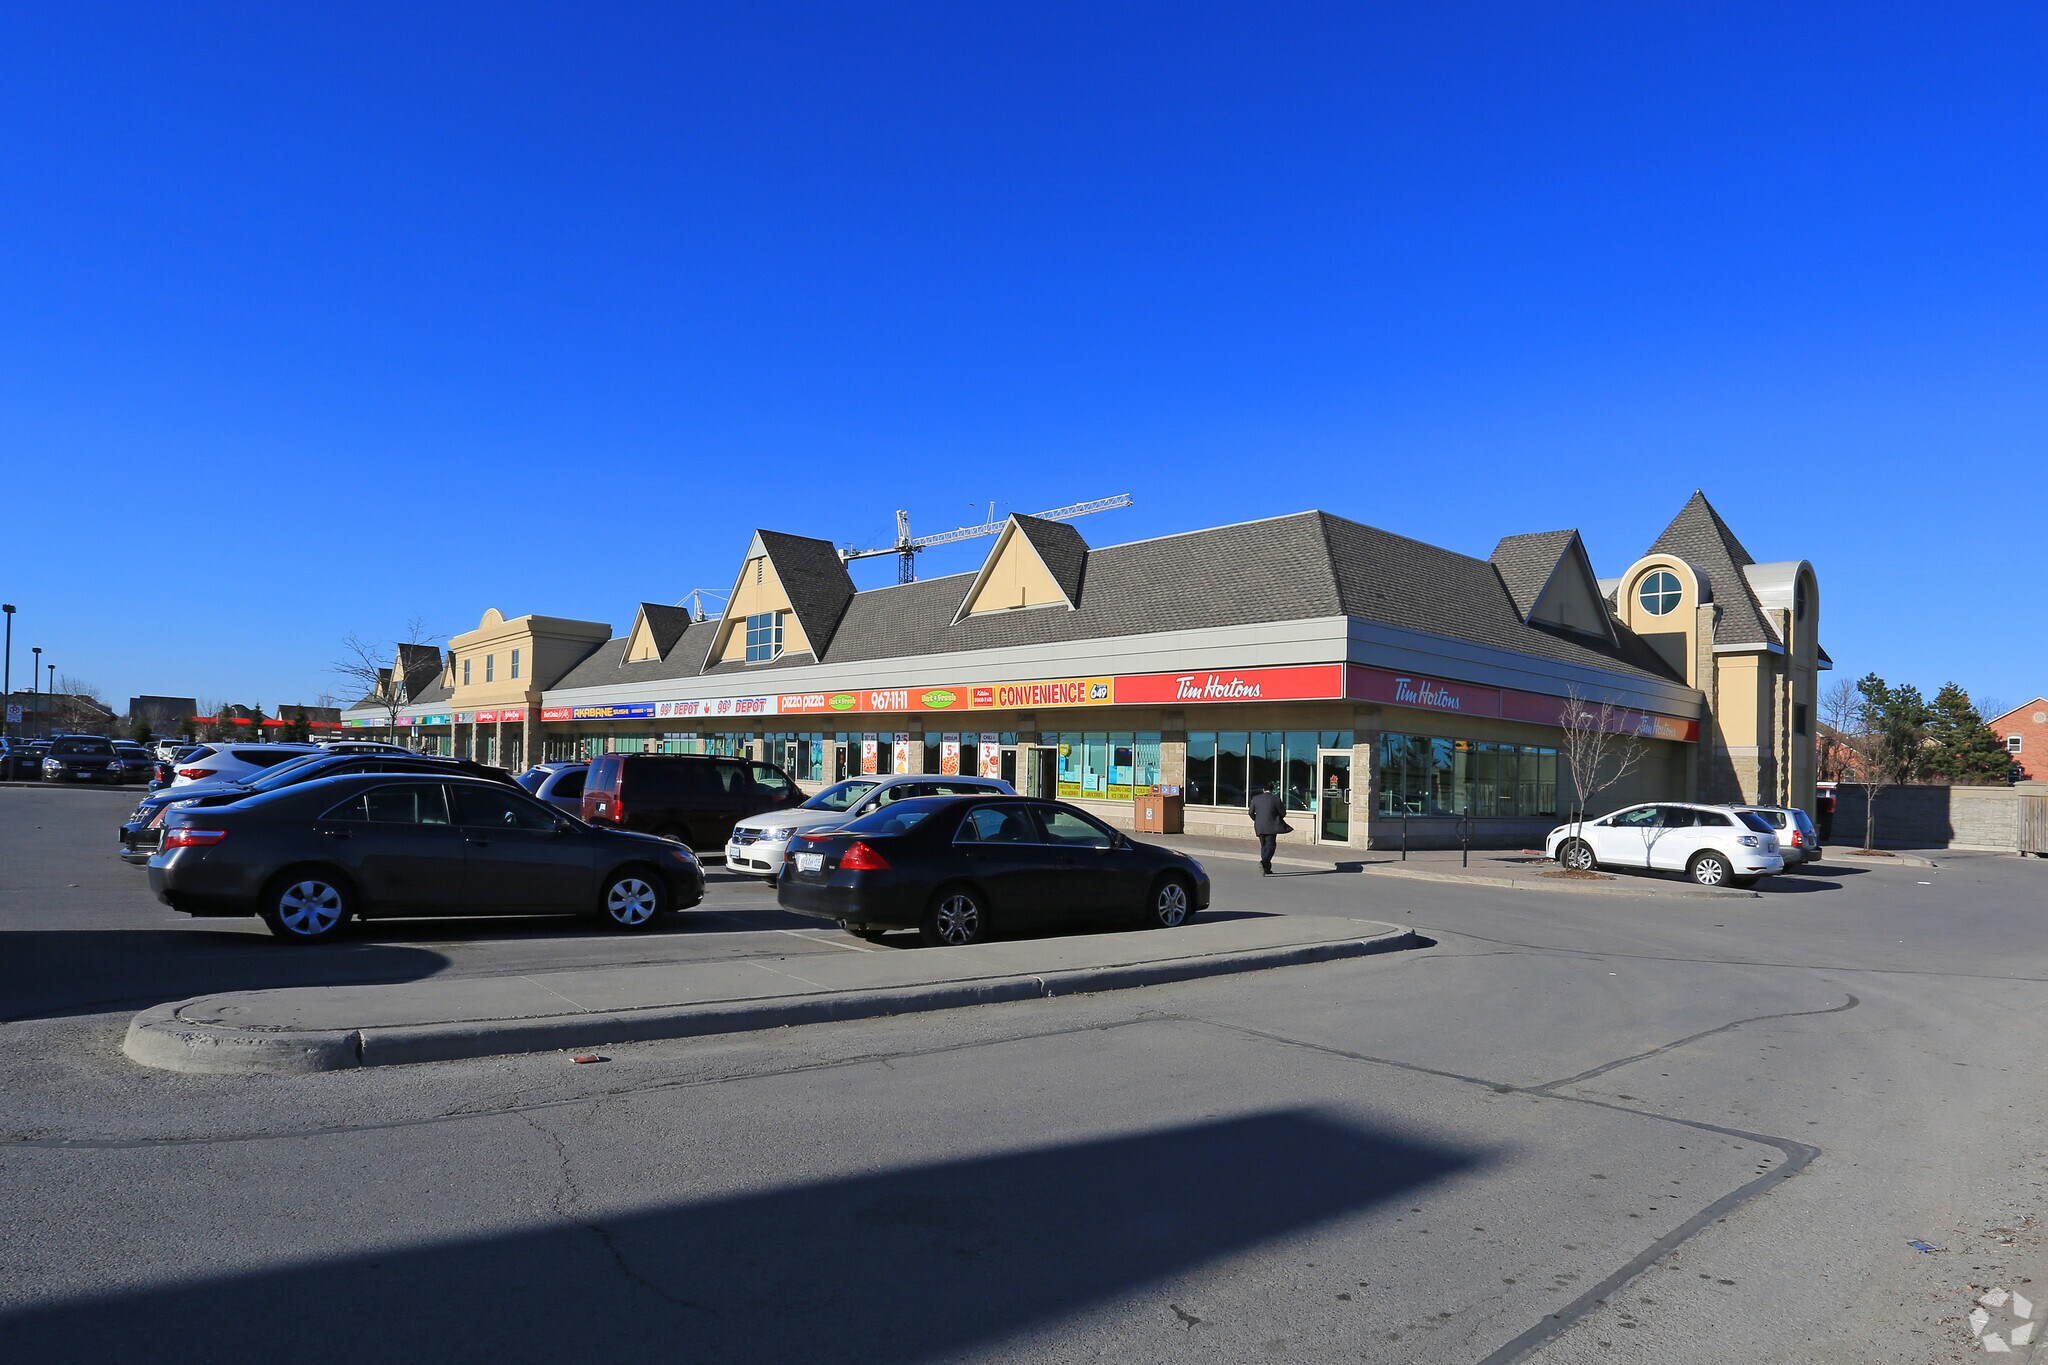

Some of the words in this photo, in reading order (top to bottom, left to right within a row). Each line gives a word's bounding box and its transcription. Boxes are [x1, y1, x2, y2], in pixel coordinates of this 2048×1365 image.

[999, 682, 1086, 707] CONVENIENCE
[1090, 683, 1108, 700] 649
[1176, 675, 1202, 700] Tim
[1203, 673, 1262, 699] Hortons
[1395, 677, 1418, 704] Tim
[1418, 680, 1461, 710] Hortons
[735, 698, 767, 713] DEPOT
[781, 695, 802, 712] pizza
[802, 694, 825, 712] pizza
[938, 692, 957, 702] Fresh
[573, 706, 613, 718] AKABANE
[674, 701, 699, 715] DEPOT
[1653, 717, 1677, 737] Hortons
